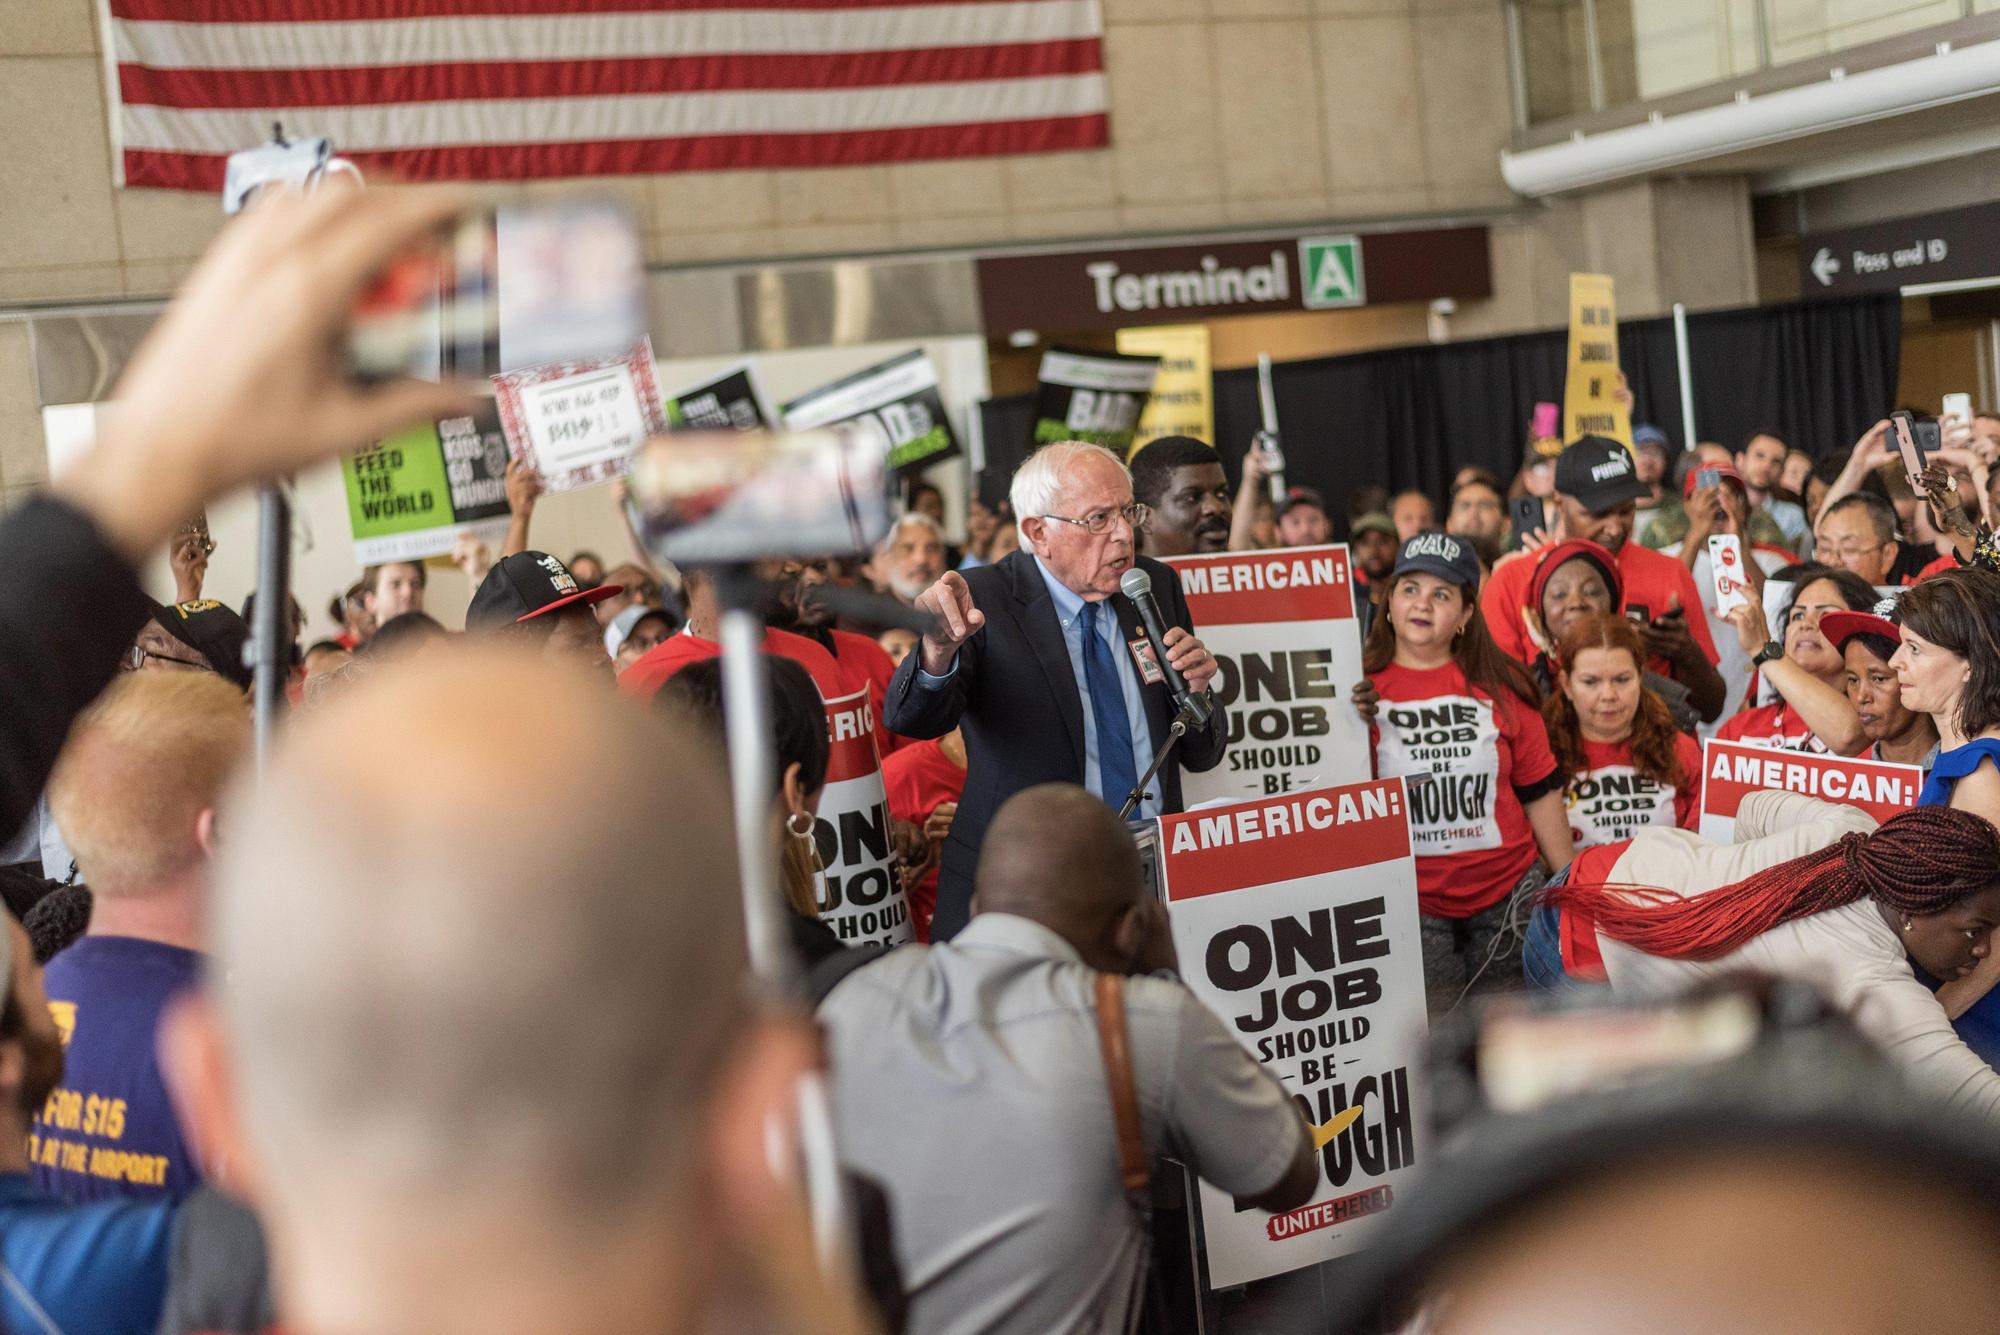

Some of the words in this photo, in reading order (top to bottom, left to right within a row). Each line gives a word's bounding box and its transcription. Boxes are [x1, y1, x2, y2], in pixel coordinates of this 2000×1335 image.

[1853, 250, 1890, 274] Pass
[1893, 240, 1924, 267] and
[1926, 238, 1948, 262] ID
[1086, 250, 1289, 312] Terminal
[1311, 247, 1356, 299] A
[355, 450, 403, 475] FEED
[359, 475, 393, 497] THE
[362, 490, 434, 522] WORLD
[1180, 557, 1345, 595] MERICAN:
[1388, 703, 1479, 729] ONE
[1401, 727, 1478, 745] JOB
[1228, 744, 1321, 772] SHOULD
[1410, 746, 1471, 760] SHOULD
[1432, 761, 1452, 774] BE
[1263, 771, 1293, 795] BE
[1573, 774, 1659, 799] ONE
[1711, 753, 1913, 807] AMERICAN:
[1408, 773, 1489, 825] NOUGH
[1582, 797, 1656, 814] JOB
[1171, 787, 1400, 854] AMERICAN:
[1592, 814, 1650, 828] SHOULD
[1613, 828, 1631, 839] BE
[826, 901, 907, 940] HOULD
[1205, 896, 1391, 992] ONE
[1234, 967, 1382, 1033] JOB
[1257, 1015, 1370, 1063] SHOULD
[1301, 1053, 1337, 1086] BE
[43, 1087, 83, 1131] FOR
[82, 1091, 128, 1141] $15
[61, 1141, 89, 1174] THE
[89, 1147, 170, 1187] AIRPORT
